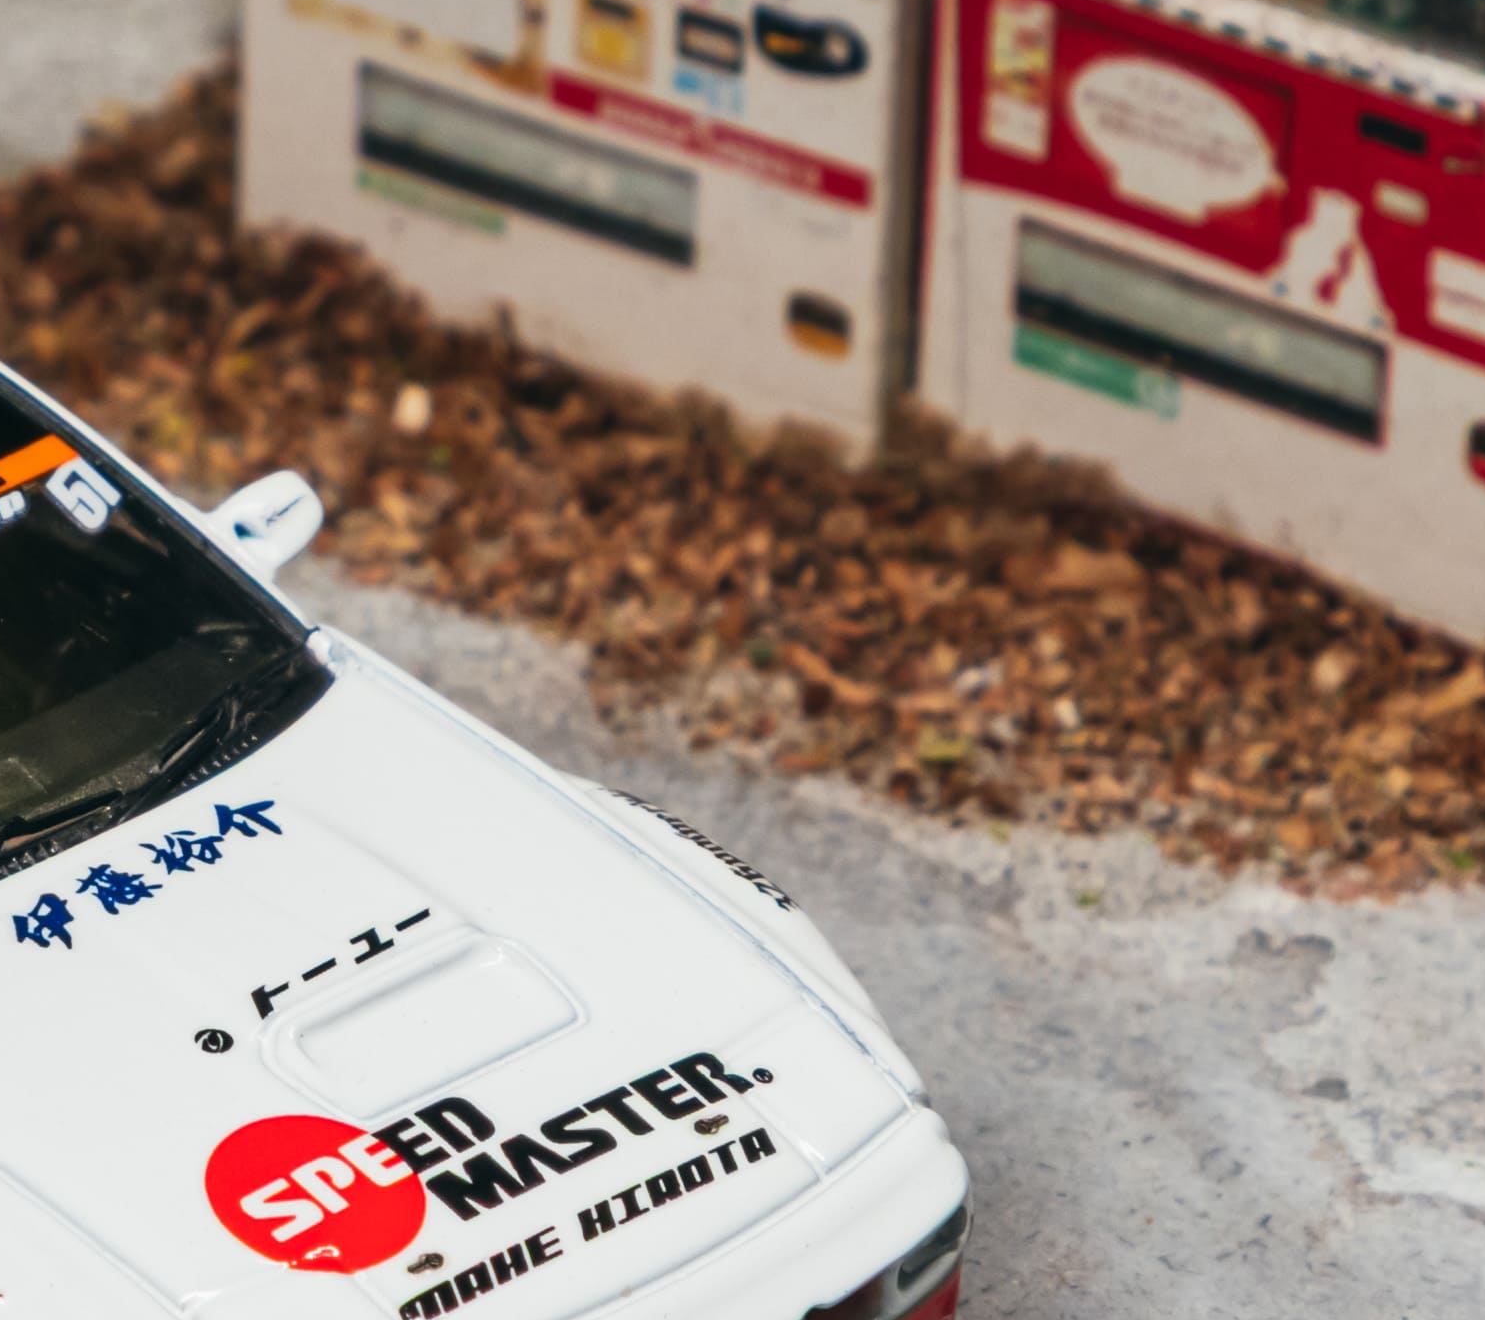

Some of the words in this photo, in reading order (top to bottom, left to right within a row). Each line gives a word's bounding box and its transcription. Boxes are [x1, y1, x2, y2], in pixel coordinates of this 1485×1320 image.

[45, 456, 123, 532] 51
[238, 1095, 497, 1244] SPEED
[576, 1127, 777, 1242] HIROTA
